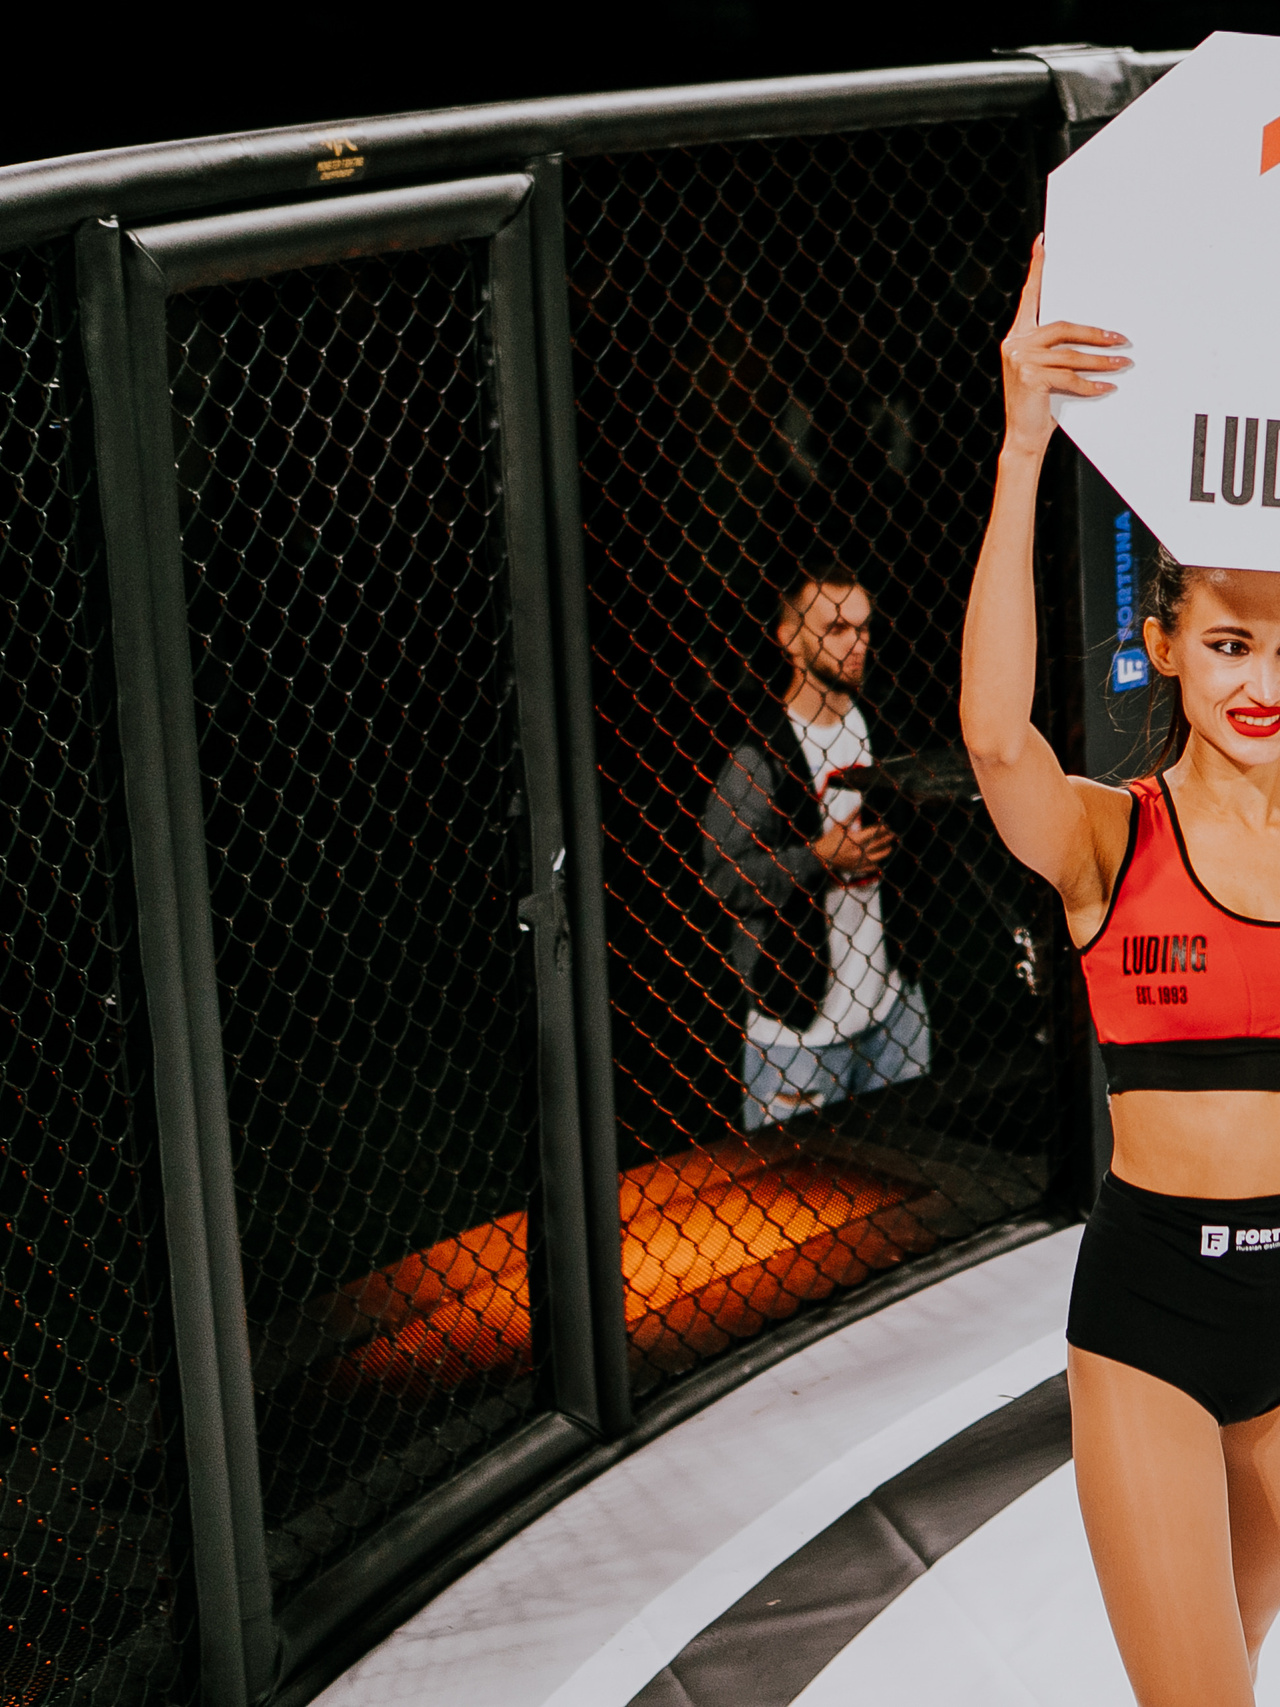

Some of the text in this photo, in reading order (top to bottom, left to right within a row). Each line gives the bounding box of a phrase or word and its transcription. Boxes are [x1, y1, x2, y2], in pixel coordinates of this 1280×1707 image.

[1114, 510, 1133, 642] FORTUNA
[1122, 934, 1207, 976] LUDING
[1136, 985, 1188, 1005] EST. 1993
